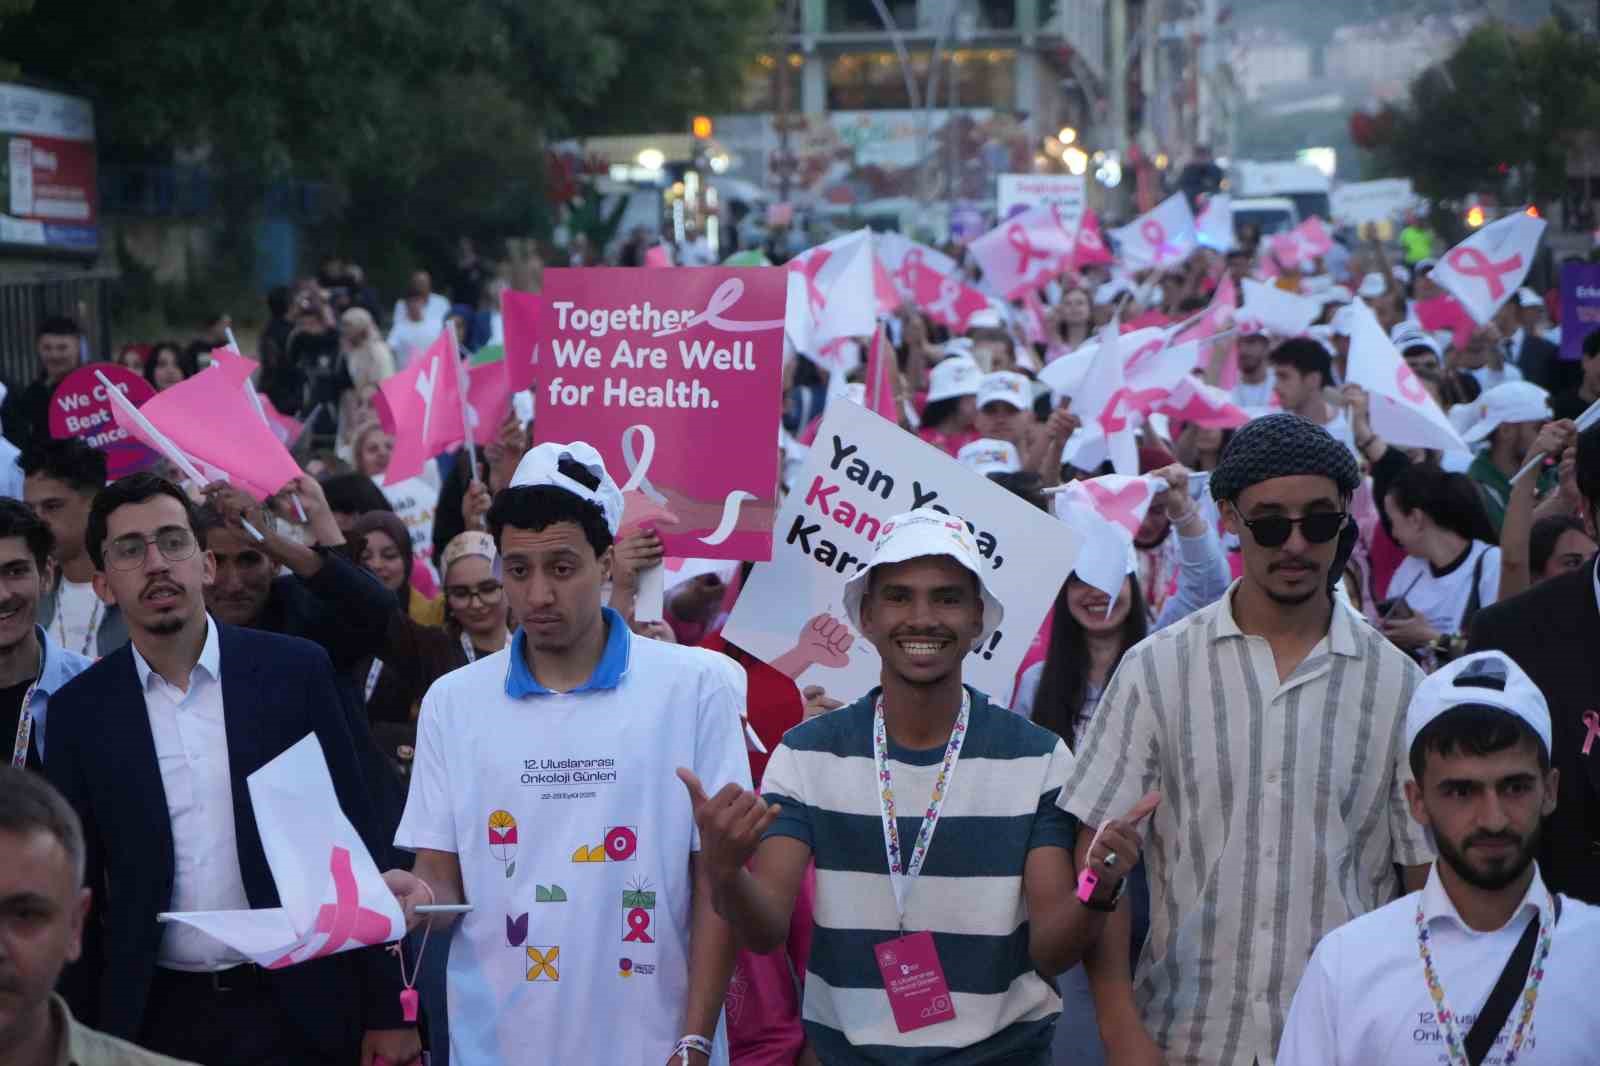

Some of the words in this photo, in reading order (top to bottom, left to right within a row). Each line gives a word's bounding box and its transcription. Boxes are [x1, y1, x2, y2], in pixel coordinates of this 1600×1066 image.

[552, 301, 696, 338] Together
[551, 339, 603, 369] We
[610, 340, 668, 370] Are
[678, 340, 756, 372] Well
[57, 393, 91, 412] We
[549, 376, 594, 406] for
[603, 377, 720, 409] Health.
[66, 408, 111, 432] Beat
[829, 434, 895, 500] Yan
[520, 772, 571, 784] Onkoloji
[574, 771, 616, 782] Günleri
[524, 759, 539, 770] 12.
